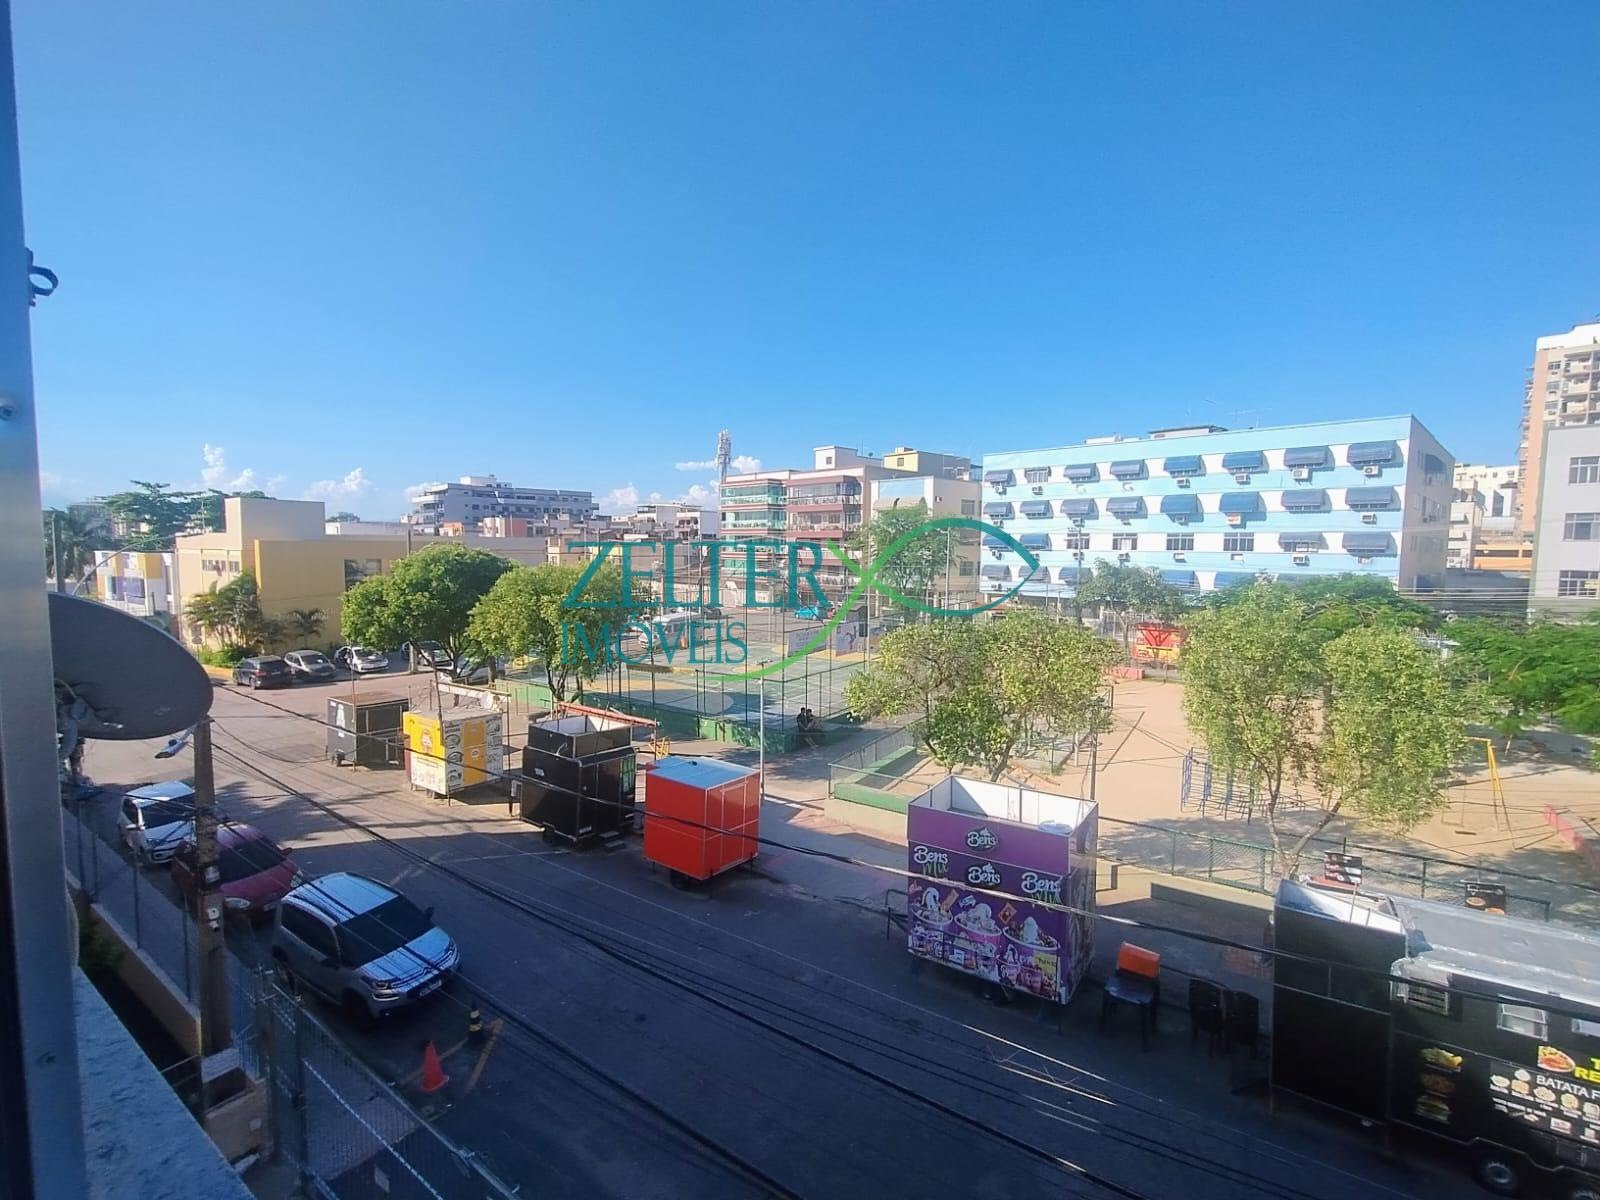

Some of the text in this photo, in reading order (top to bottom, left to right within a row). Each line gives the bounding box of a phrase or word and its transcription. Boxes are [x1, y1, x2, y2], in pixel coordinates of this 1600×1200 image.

[913, 845, 949, 864] Bens
[967, 867, 1001, 884] Bens
[1021, 872, 1062, 893] Bens
[1536, 1075, 1590, 1099] BATATA
